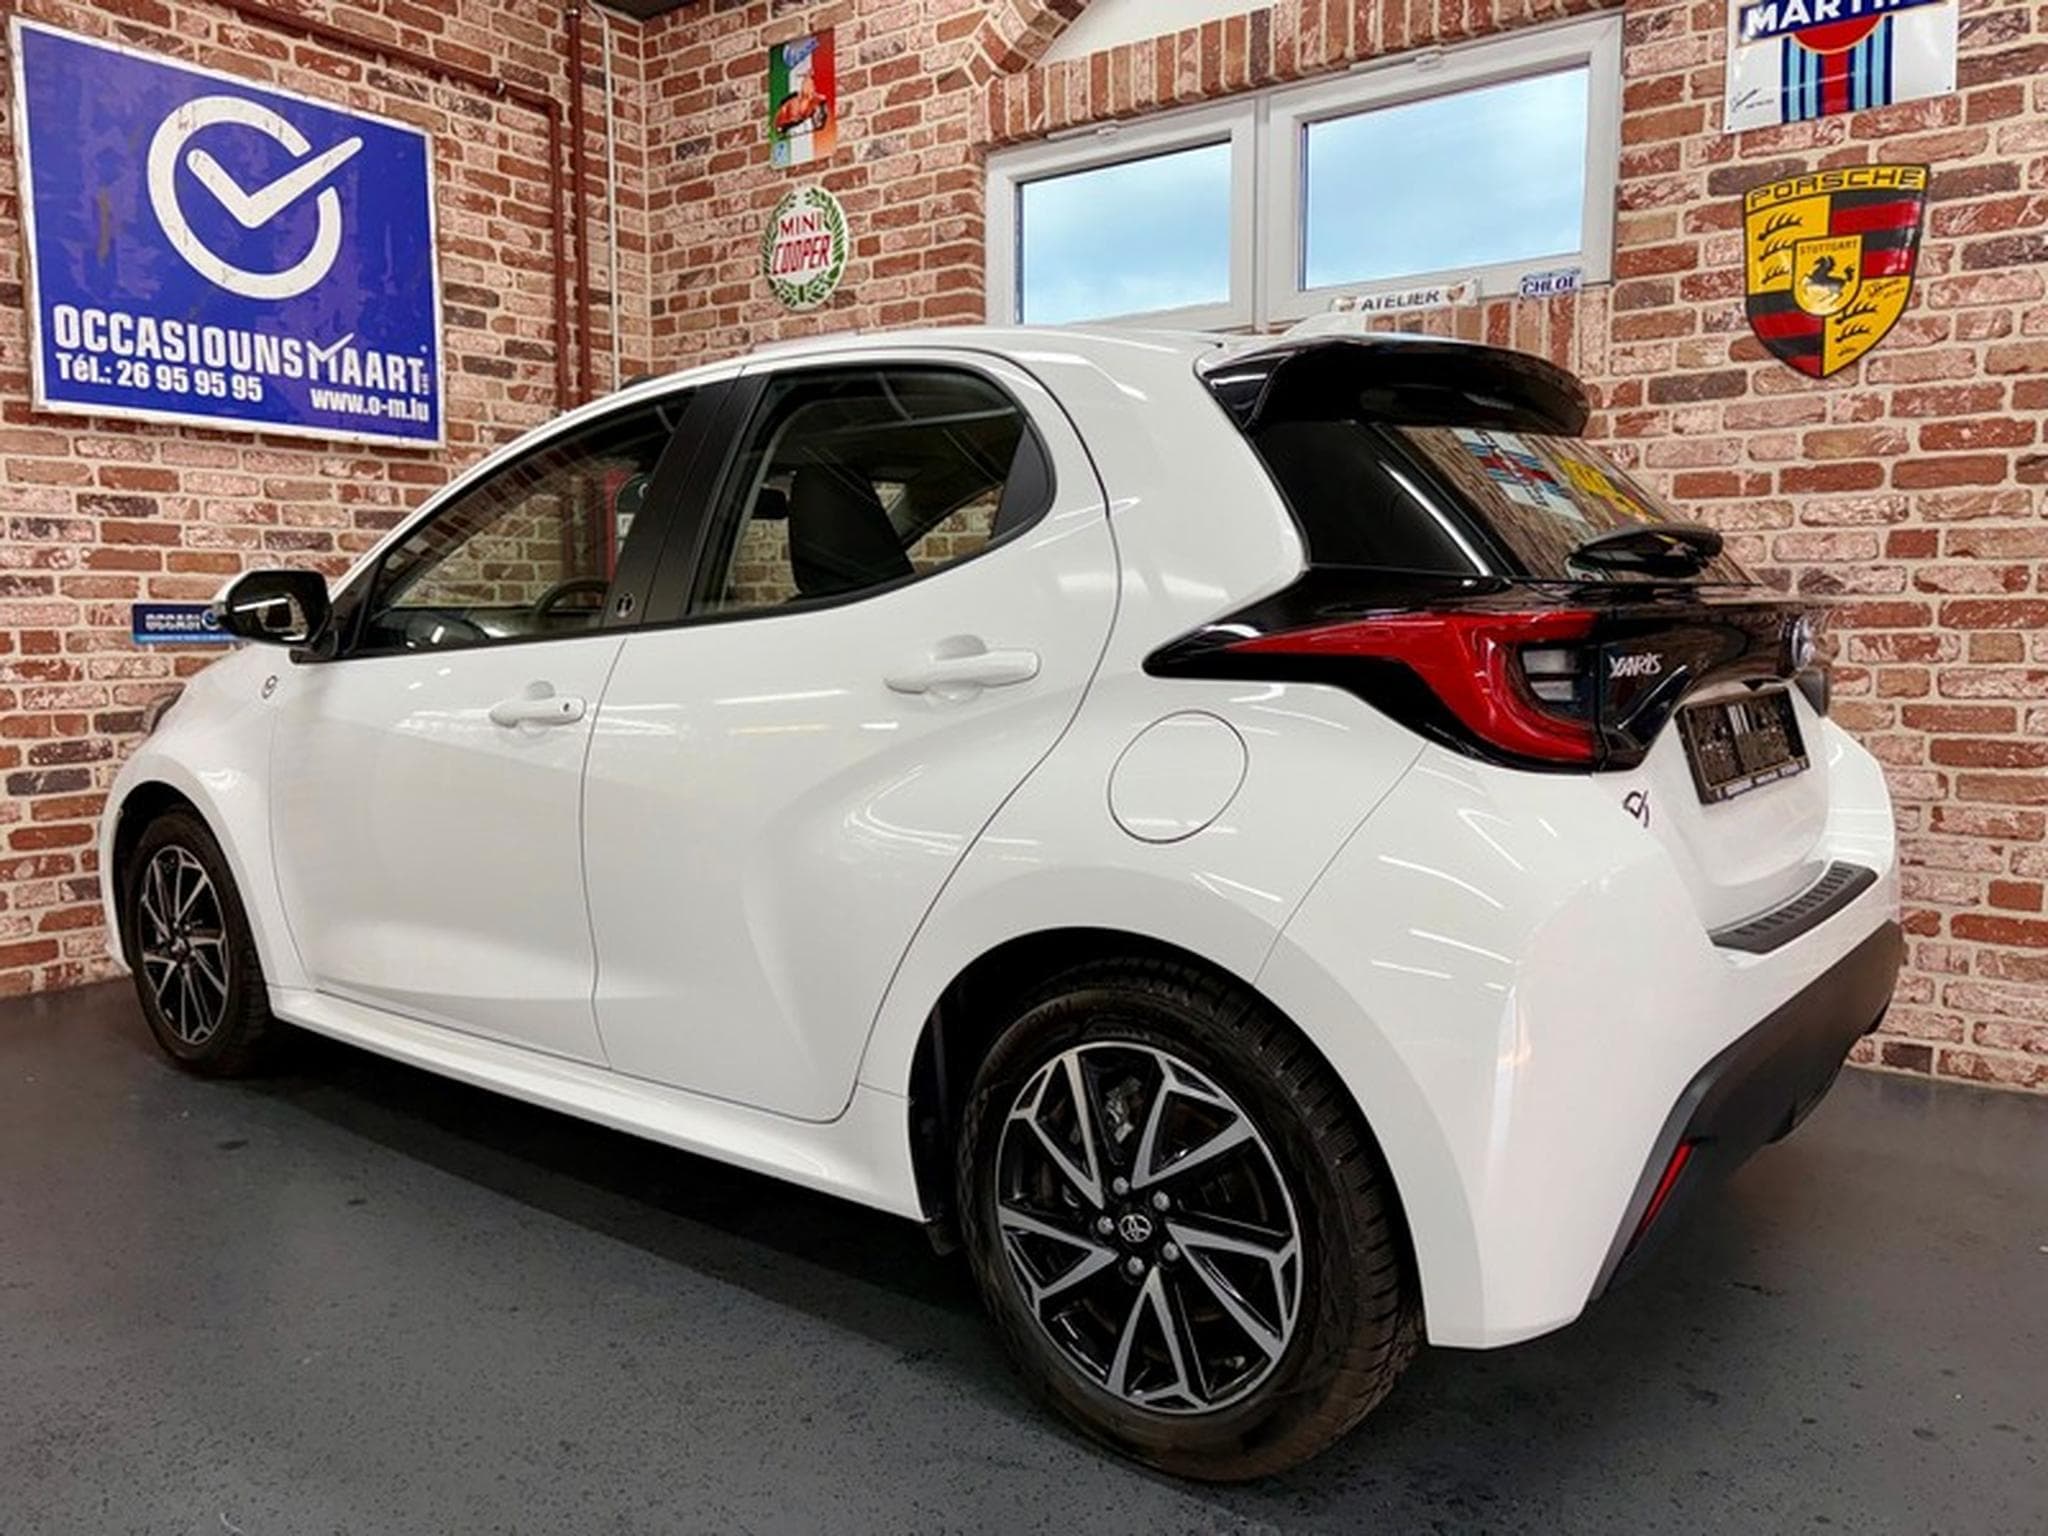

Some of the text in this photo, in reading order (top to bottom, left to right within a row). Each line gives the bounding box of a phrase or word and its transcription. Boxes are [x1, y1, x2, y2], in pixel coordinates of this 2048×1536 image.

[1750, 169, 1922, 207] PORSCHE
[780, 213, 821, 237] MINI
[774, 234, 830, 275] COOPER
[1800, 240, 1858, 254] STUTTGART
[1361, 290, 1440, 311] ATELIER
[55, 352, 263, 403] Tél.: 26 95 95 95
[310, 388, 430, 422] www.o-m.lu
[1609, 652, 1662, 678] YARIS
